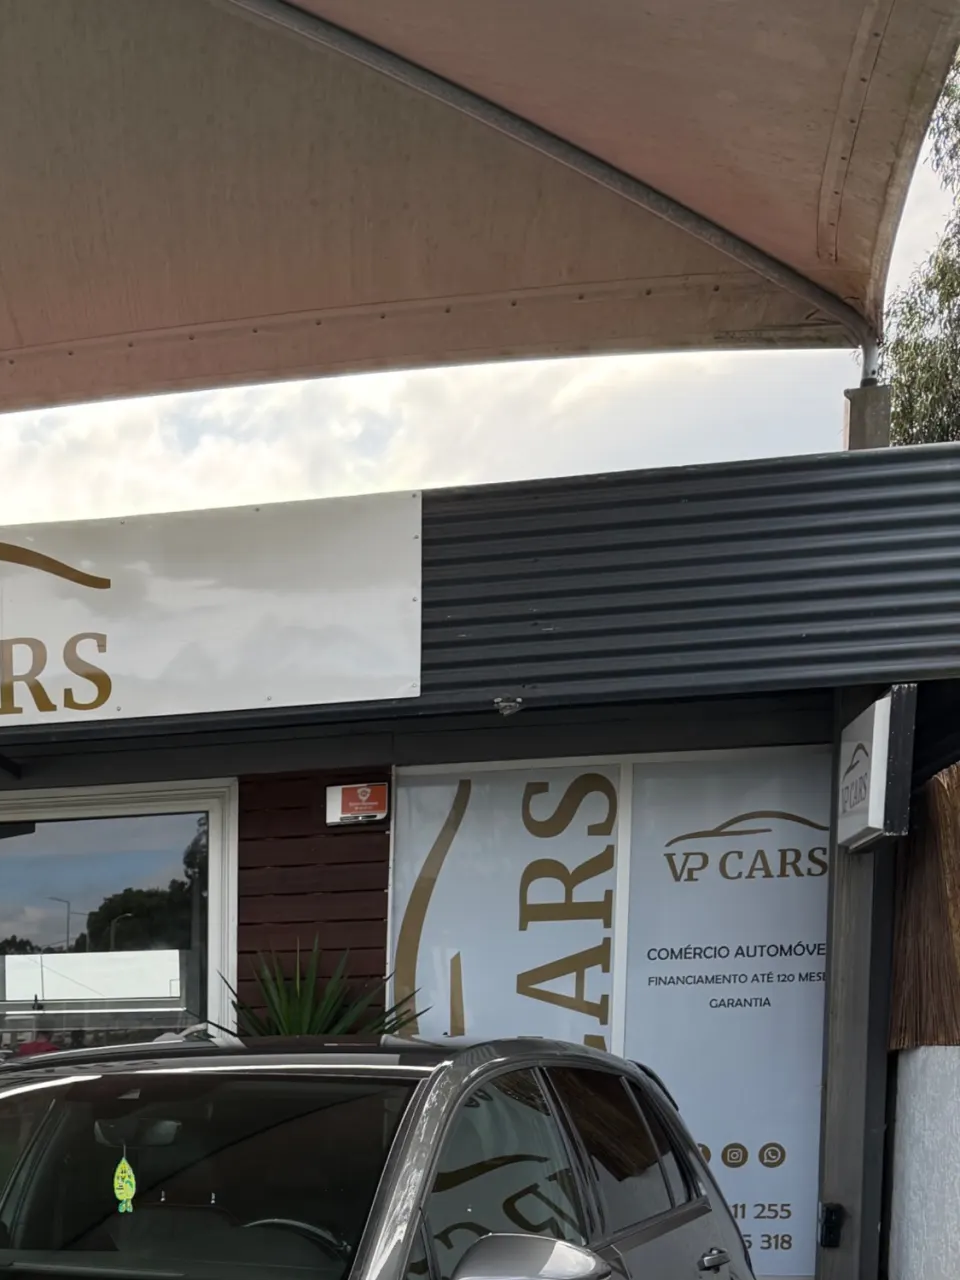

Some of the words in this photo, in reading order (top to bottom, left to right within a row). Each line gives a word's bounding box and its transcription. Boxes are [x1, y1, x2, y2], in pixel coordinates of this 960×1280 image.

[663, 851, 709, 882] VP
[718, 846, 829, 880] CARS
[516, 772, 618, 1052] ARS
[646, 944, 731, 961] COMÉRCIO
[647, 973, 748, 986] FINANCIAMENTO
[751, 971, 774, 983] ATÉ
[777, 973, 795, 983] 120
[708, 997, 772, 1009] GARANTIA
[753, 1203, 792, 1219] 255
[759, 1234, 793, 1250] 318
